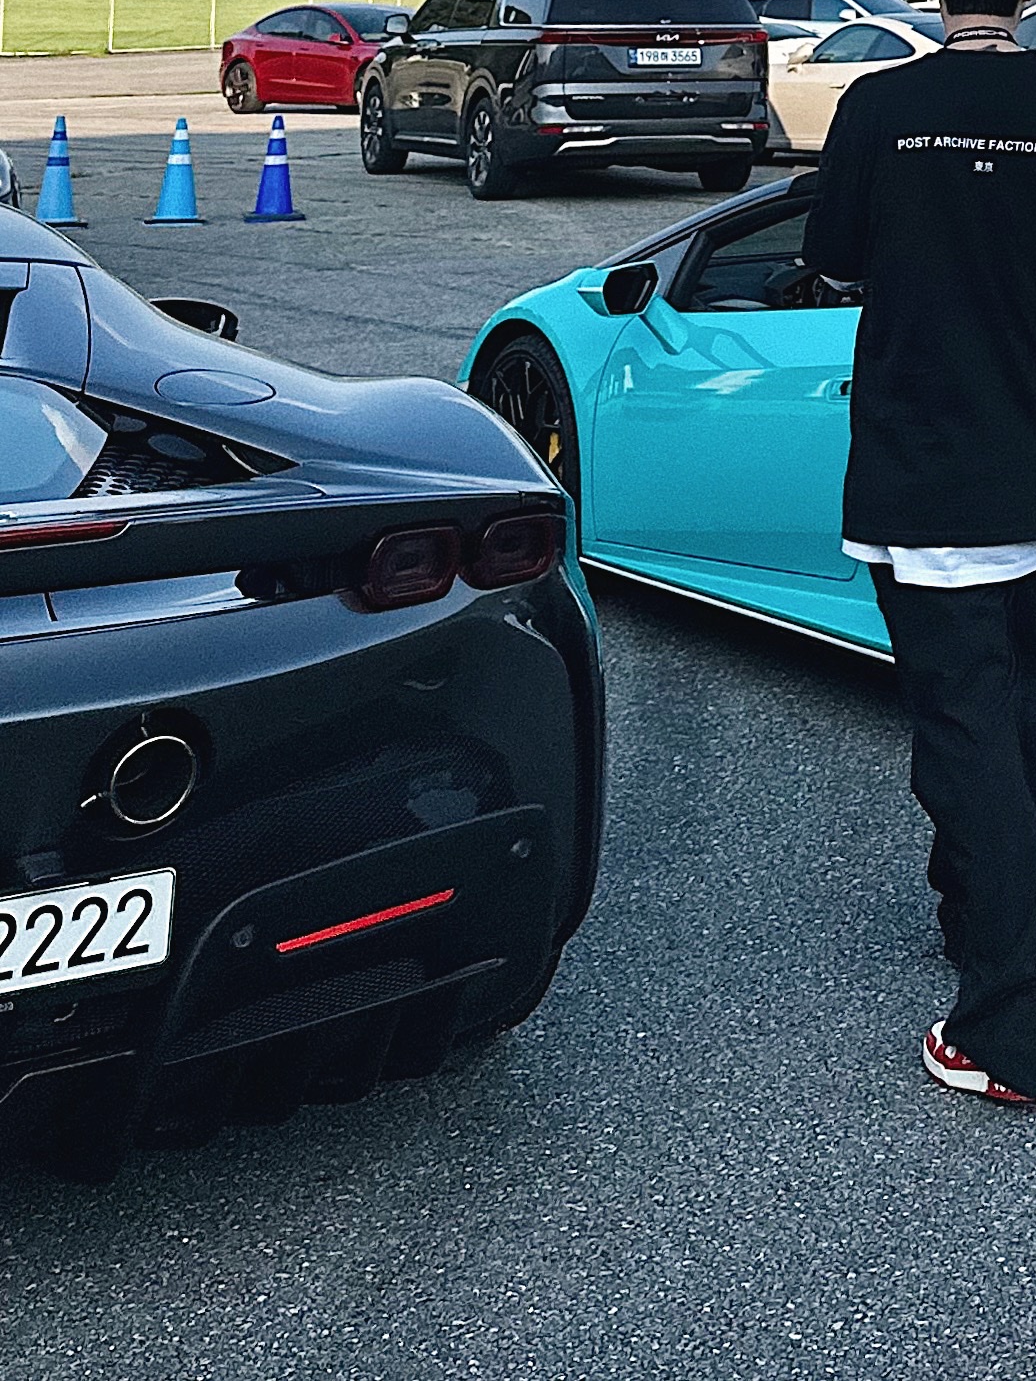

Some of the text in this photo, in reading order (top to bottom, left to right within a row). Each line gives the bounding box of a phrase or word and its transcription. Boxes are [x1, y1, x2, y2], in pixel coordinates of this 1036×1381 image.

[671, 50, 698, 62] 3565
[897, 136, 931, 150] POST
[933, 136, 986, 150] ARCHIVE
